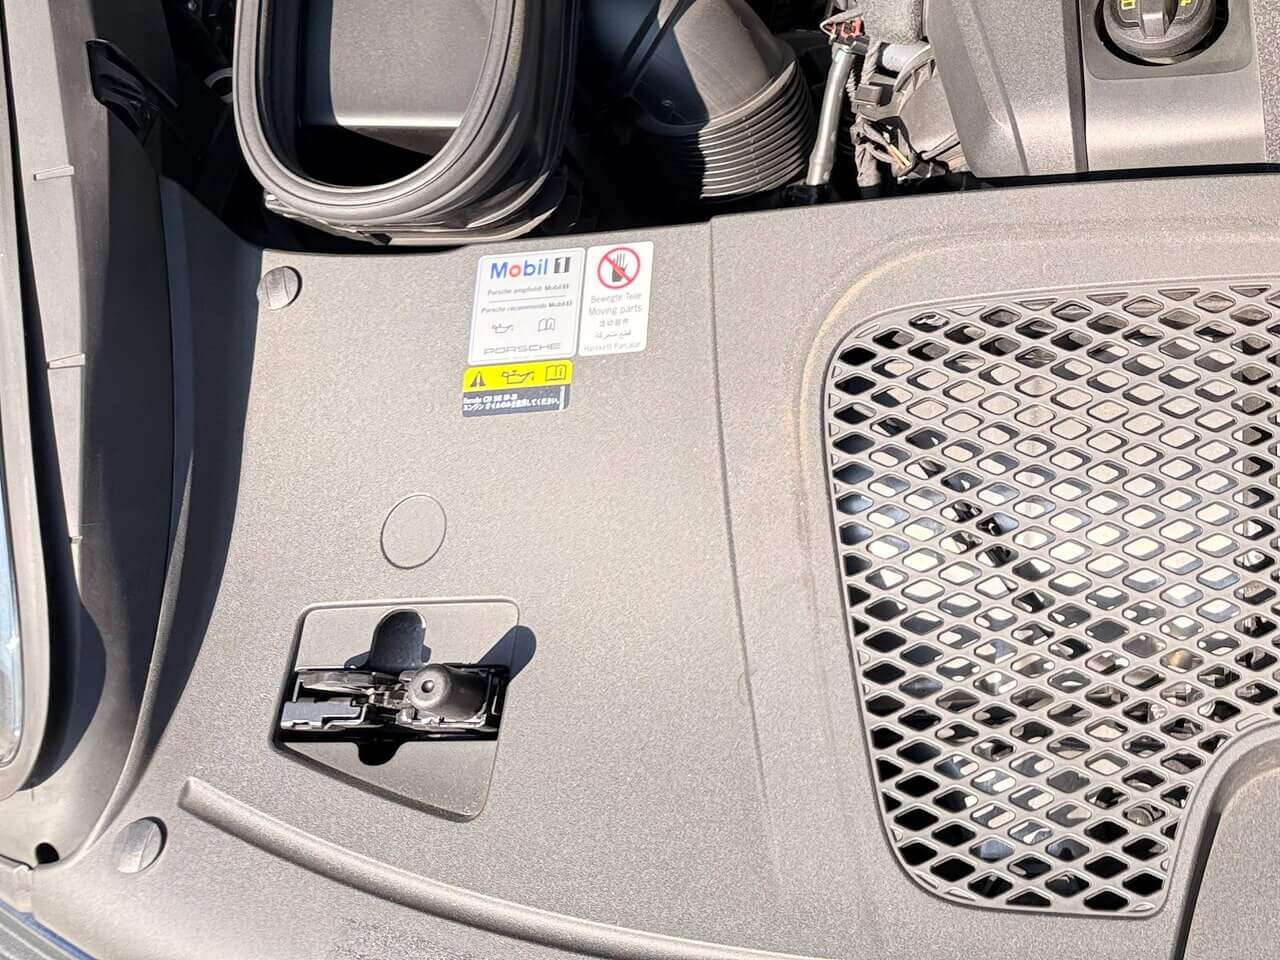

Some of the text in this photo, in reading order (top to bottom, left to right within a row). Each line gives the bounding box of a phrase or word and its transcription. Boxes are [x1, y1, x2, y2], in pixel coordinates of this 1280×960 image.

[490, 256, 571, 279] Mobil 1
[619, 304, 643, 314] parts
[483, 342, 561, 355] PORSCHE
